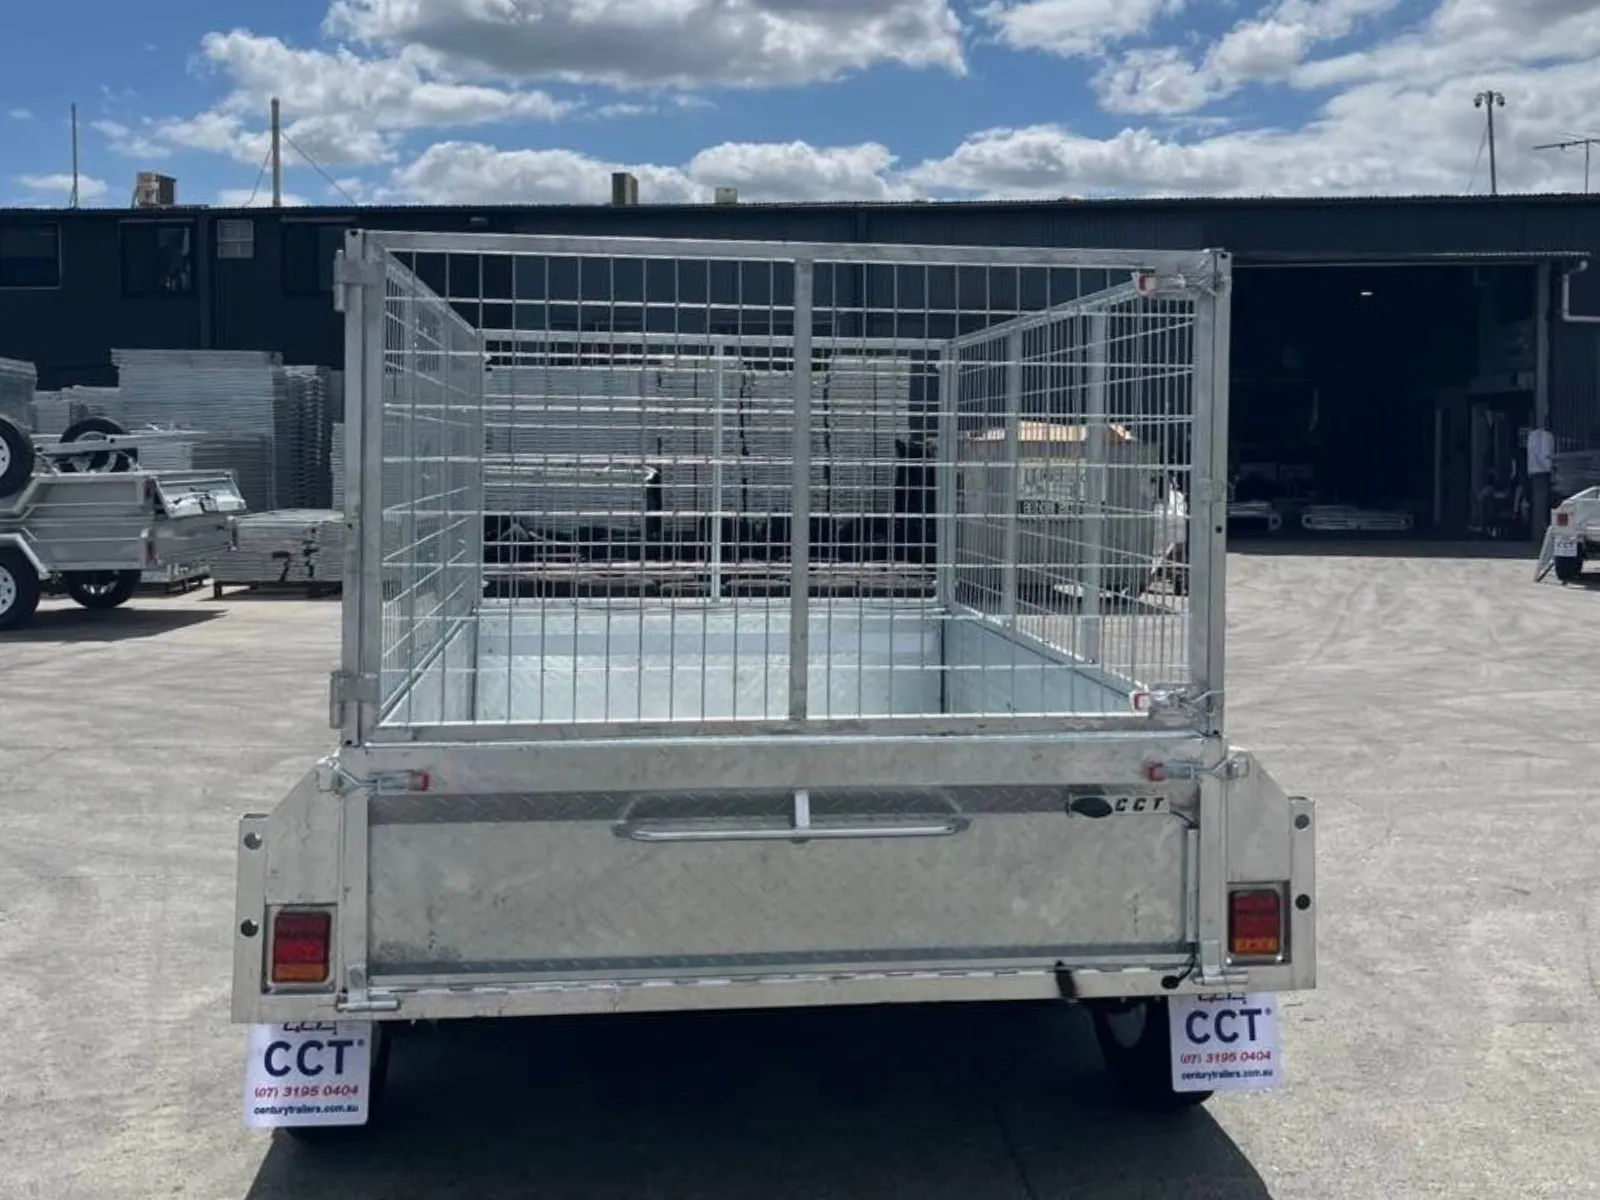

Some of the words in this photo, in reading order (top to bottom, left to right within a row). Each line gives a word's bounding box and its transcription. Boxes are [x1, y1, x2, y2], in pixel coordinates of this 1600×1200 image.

[1115, 798, 1165, 812] CCT
[1180, 1053, 1202, 1065] (07)
[1206, 1052, 1237, 1064] 3195
[1240, 1050, 1272, 1062] 0404
[1181, 1069, 1274, 1081] centurytrailers.com.au
[254, 1086, 279, 1099] (07)
[282, 1085, 319, 1098] 3195
[322, 1084, 359, 1097] 0404
[253, 1104, 359, 1117] centurytrailers.com.au
